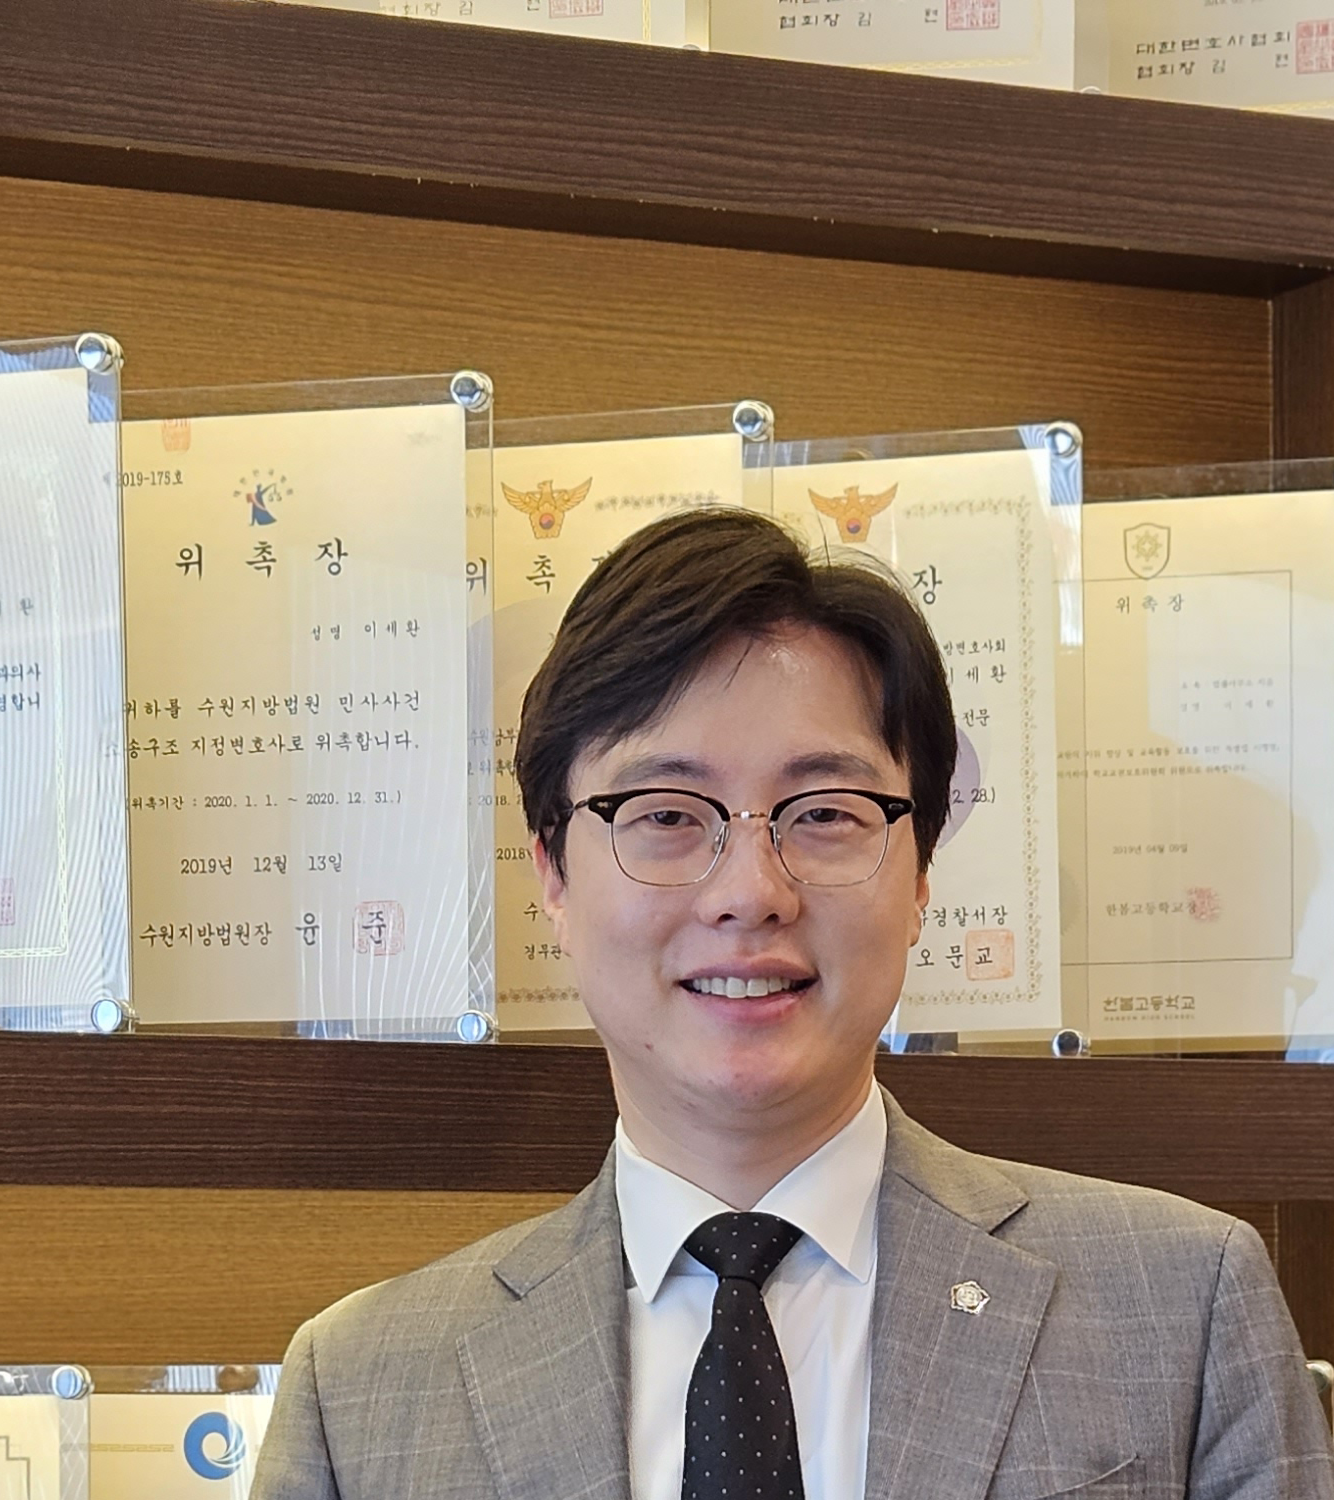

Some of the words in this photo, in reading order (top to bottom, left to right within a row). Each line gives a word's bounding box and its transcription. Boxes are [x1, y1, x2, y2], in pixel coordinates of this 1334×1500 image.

[911, 564, 942, 605] 장
[198, 694, 320, 718] 수원지방법원
[340, 691, 419, 714] 민사사건
[191, 735, 304, 757] 지정변호사로
[316, 729, 419, 752] 위촉합니다.
[971, 786, 995, 804] 28.)
[181, 857, 231, 875] 2019년
[254, 855, 286, 874] 12월
[308, 853, 342, 872] 13일
[139, 922, 272, 947] 수원지방법원장
[296, 912, 319, 946] 윤
[362, 911, 387, 945] 준
